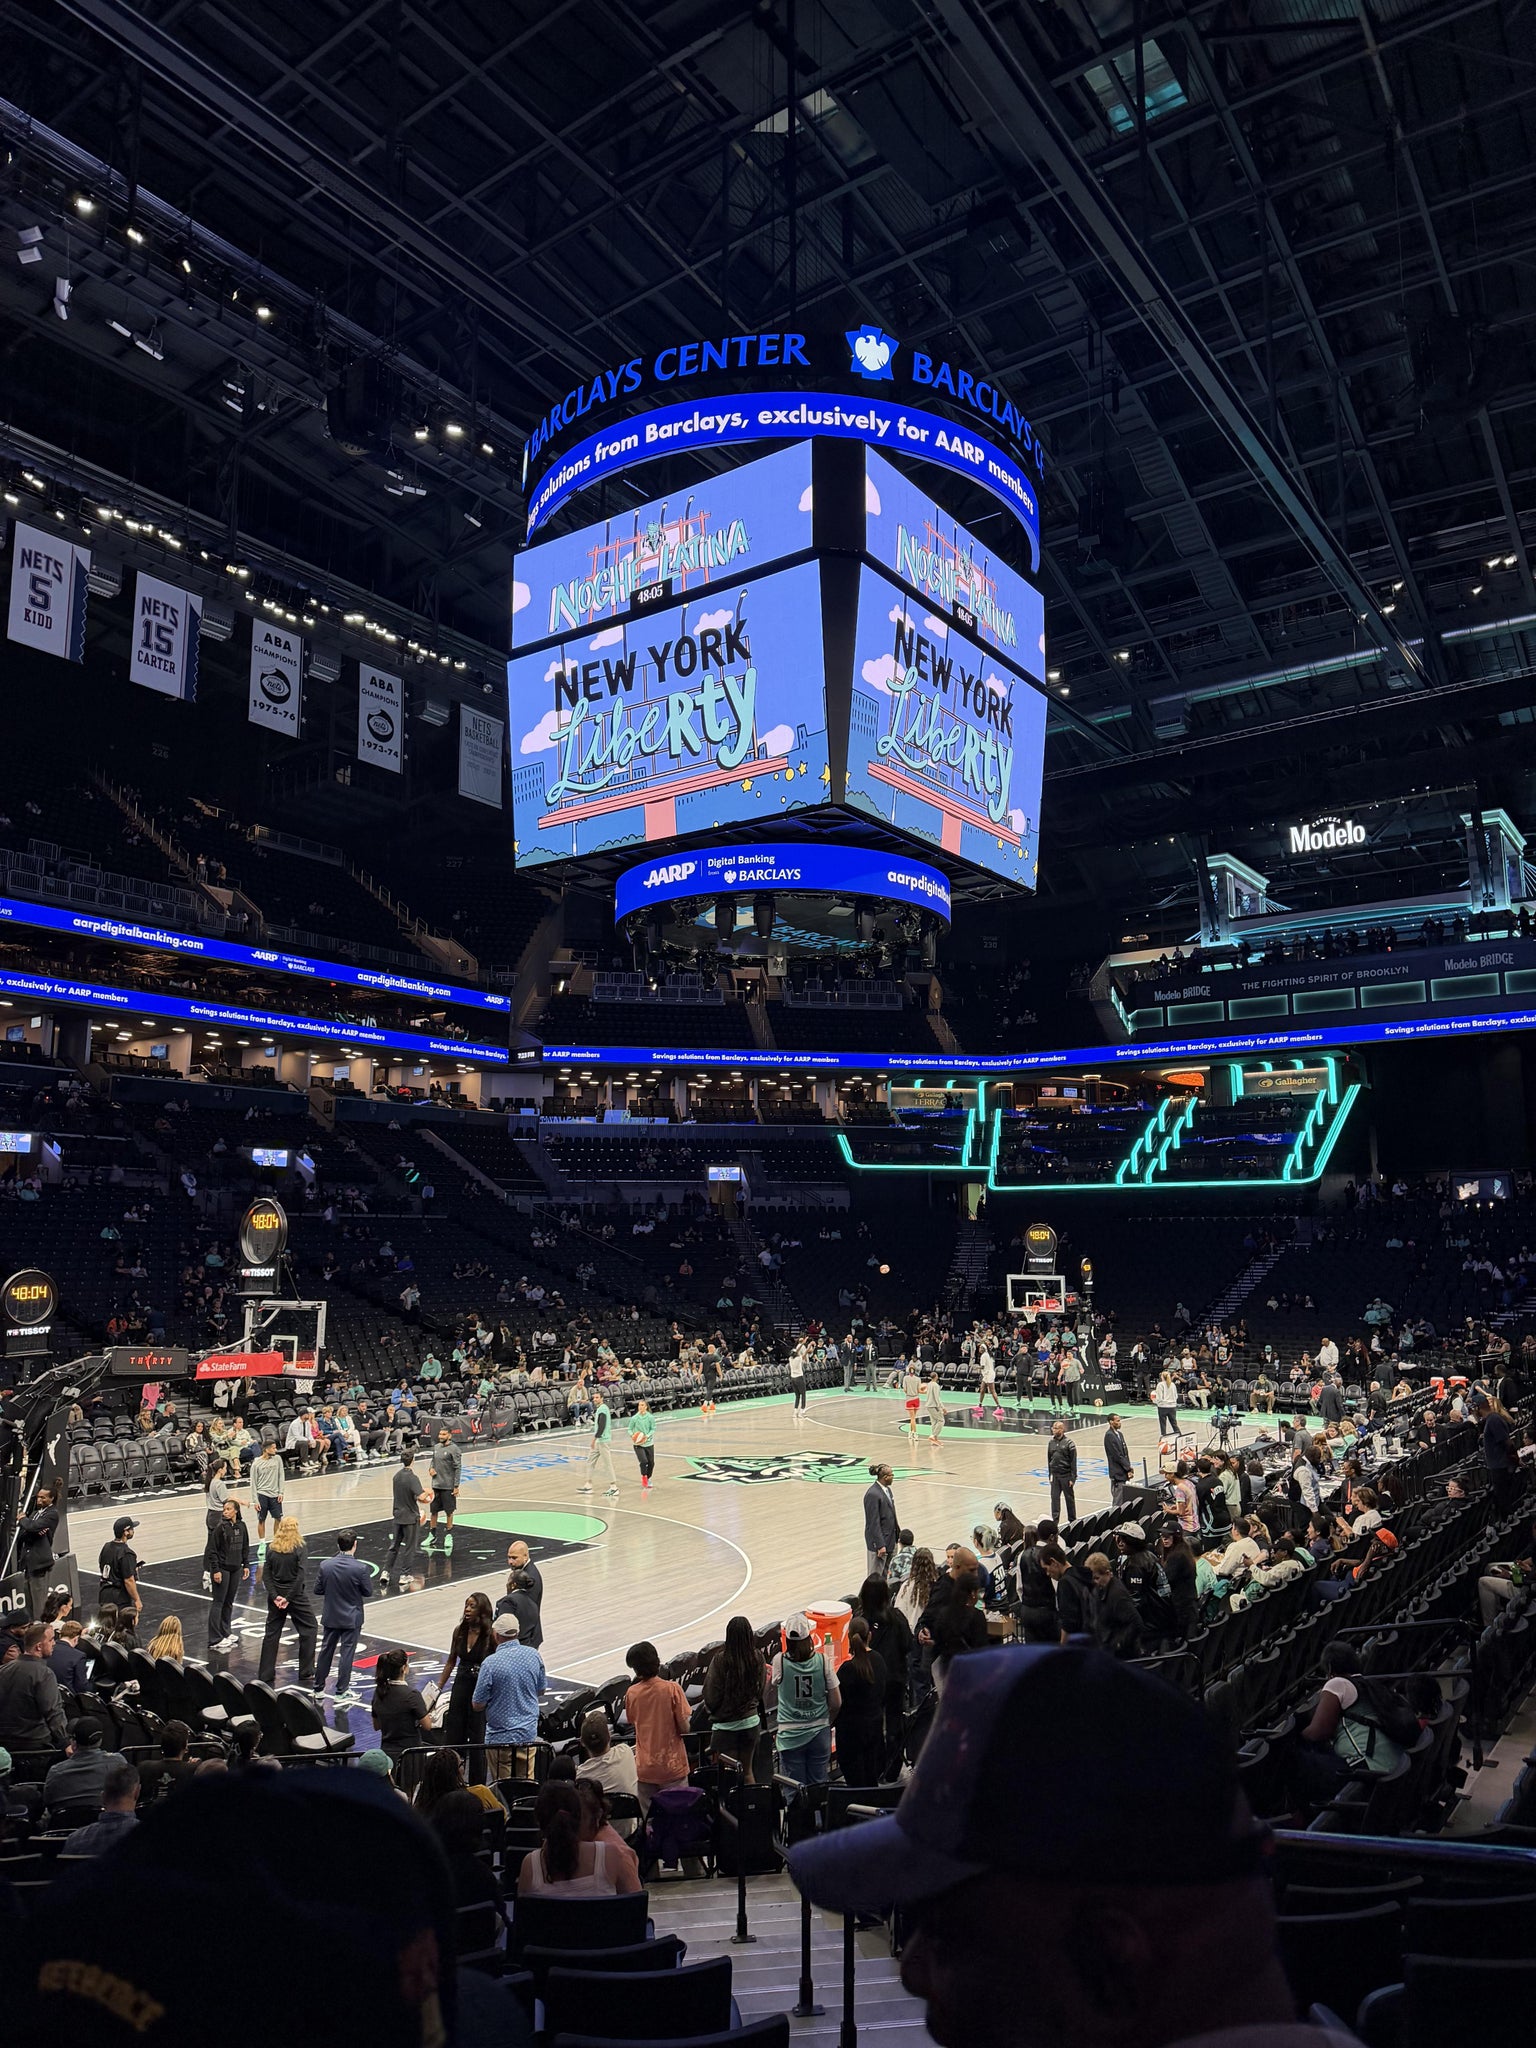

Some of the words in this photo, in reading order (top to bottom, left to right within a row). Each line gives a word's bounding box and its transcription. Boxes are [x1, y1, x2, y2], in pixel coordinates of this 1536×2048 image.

[530, 358, 643, 463] BARCLAYS
[654, 333, 811, 382] CENTER
[912, 352, 1032, 451] BARCLAYS
[539, 454, 590, 508] solutions
[595, 433, 638, 463] from
[645, 411, 749, 443] Barclays,
[757, 404, 891, 437] exclusively
[898, 417, 929, 442] for
[934, 430, 985, 465] AARP
[988, 459, 1034, 516] members
[20, 547, 64, 584] NETS
[28, 573, 52, 612] 5
[637, 584, 664, 604] 48:05
[24, 607, 52, 630] KIDD
[141, 596, 179, 629] NETS
[140, 618, 174, 657] 15
[263, 632, 292, 652] ABA
[137, 650, 176, 675] CARTER
[253, 645, 298, 667] CHAMPIONS
[554, 650, 637, 712] NEW
[648, 619, 752, 683] YORK
[369, 675, 395, 694] ABA
[894, 618, 954, 693] NEW
[959, 665, 1013, 739] YORK
[361, 687, 399, 708] CHAMPIONS
[252, 699, 296, 721] 1975-76
[472, 716, 492, 736] NETS
[361, 738, 399, 758] 1973-74
[464, 726, 499, 750] BASKETBALL
[1289, 819, 1366, 854] Modelo
[707, 856, 737, 868] Digital
[738, 854, 775, 867] Banking
[643, 861, 696, 888] AARP
[739, 869, 801, 881] BARCLAYS
[73, 917, 203, 950] aarpdigitalbanking.com
[250, 950, 279, 962] AARP
[1444, 959, 1478, 972] Modelo
[1479, 952, 1514, 968] BRIDGE
[357, 972, 451, 997] aarpdigitalbanking.com
[1242, 981, 1260, 991] THE
[1262, 976, 1306, 989] FIGHTING
[1307, 973, 1339, 984] SPIRIT
[1341, 971, 1353, 981] OF
[1356, 965, 1409, 979] BROOKLYN
[6, 978, 52, 992] exclusively
[54, 983, 67, 994] for
[68, 987, 92, 997] AARP
[93, 991, 129, 1003] members
[1154, 989, 1182, 1002] Modelo
[1182, 985, 1211, 999] BRIDGE
[190, 1005, 218, 1017] Savings
[219, 1010, 249, 1021] solutions
[250, 1013, 266, 1024] from
[267, 1016, 296, 1028] Barclays,
[297, 1022, 330, 1034] exclusively
[331, 1026, 340, 1035] for
[342, 1028, 359, 1037] AARP
[359, 1032, 386, 1041] members
[1385, 1026, 1415, 1035] Savings
[1416, 1023, 1450, 1033] solutions
[1451, 1021, 1471, 1029] from
[1472, 1018, 1508, 1028] Barclays,
[473, 1047, 485, 1056] from
[1116, 1048, 1141, 1057] Savings
[1141, 1046, 1169, 1054] solutions
[1187, 1043, 1217, 1051] Barclays,
[1218, 1038, 1255, 1048] exclusively
[1256, 1037, 1267, 1045] for
[1268, 1036, 1289, 1044] AARP
[1289, 1034, 1323, 1043] members
[652, 1053, 677, 1061] Savings
[705, 1053, 721, 1061] from
[889, 1058, 912, 1066] Savings
[939, 1058, 954, 1066] from
[1013, 1057, 1022, 1065] for
[1040, 1055, 1066, 1063] members
[1275, 1077, 1317, 1086] Gallagher
[913, 1099, 946, 1107] TERRAC
[252, 1213, 279, 1229] 48:04
[1030, 1231, 1050, 1240] 48:04
[250, 1268, 275, 1276] TISSOT
[11, 1285, 48, 1300] 48:04
[19, 1326, 51, 1336] TISSOT
[794, 1675, 813, 1698] 13
